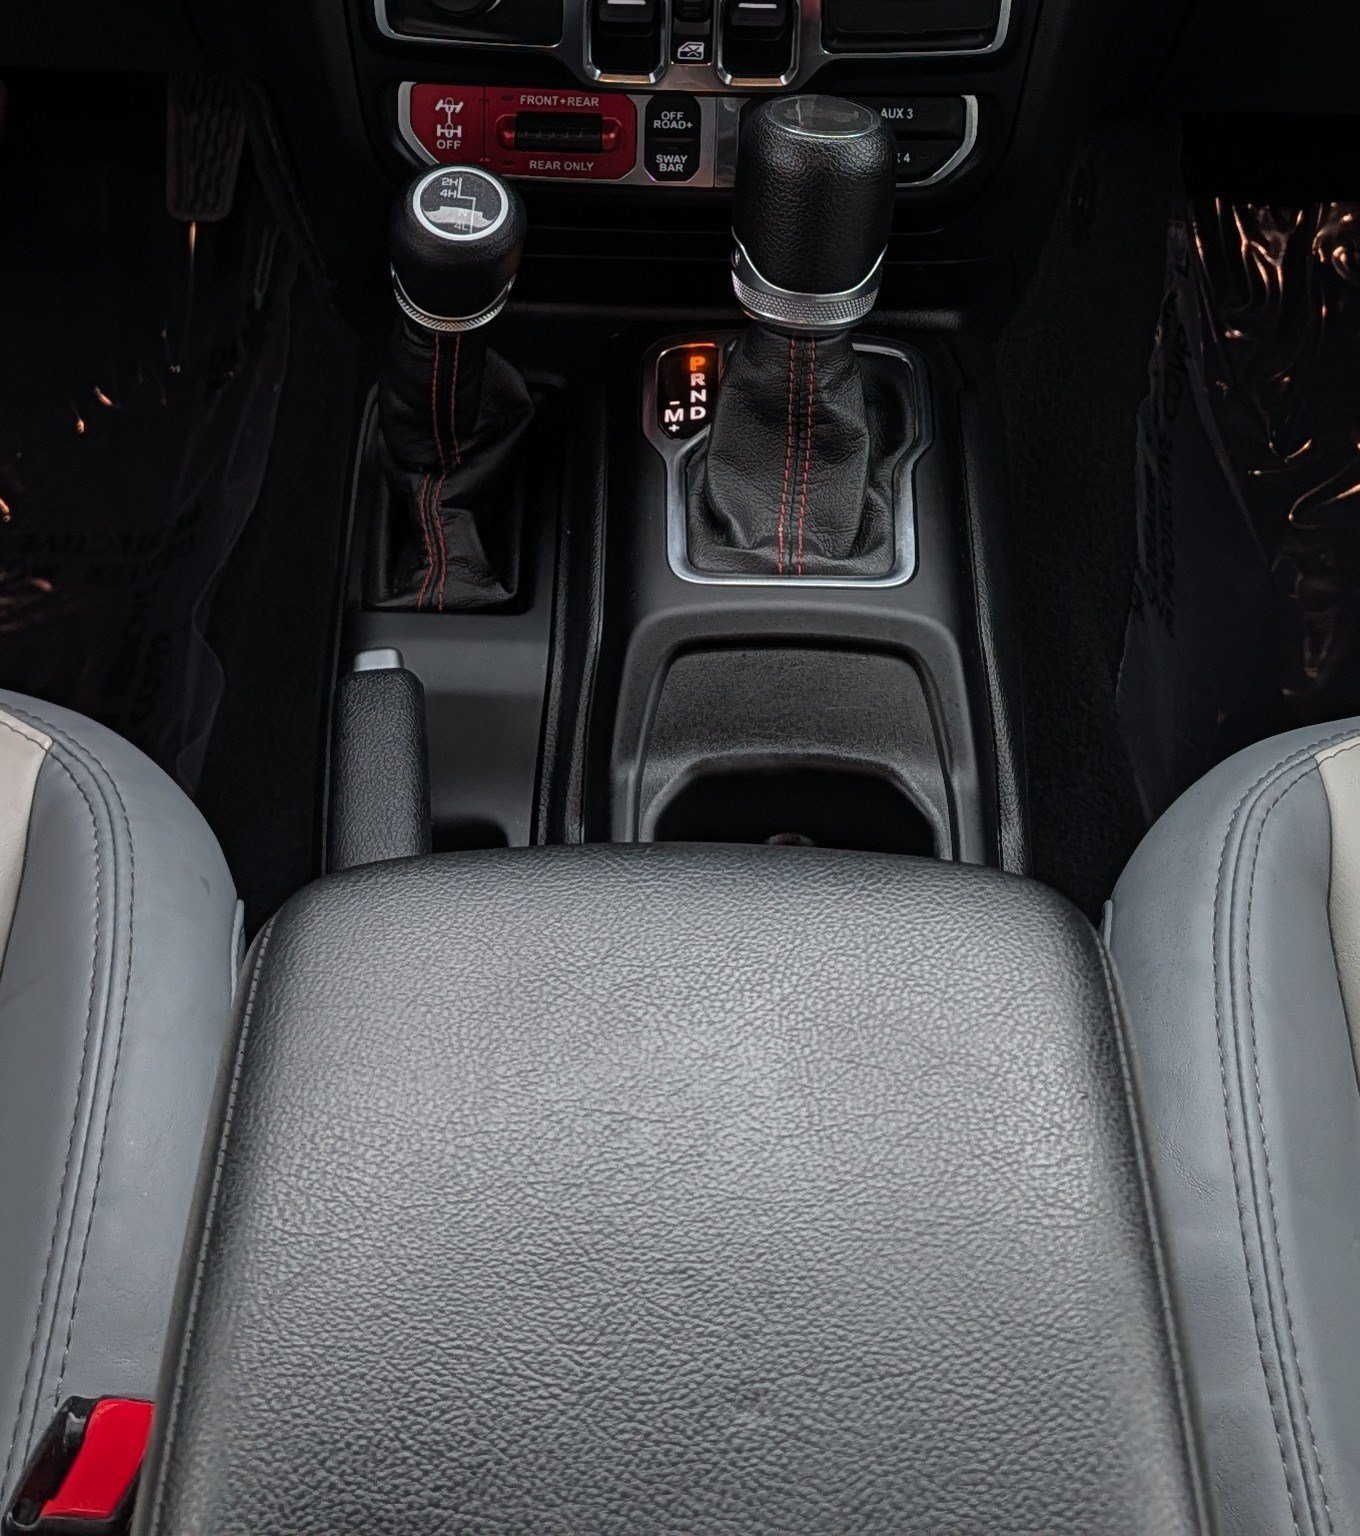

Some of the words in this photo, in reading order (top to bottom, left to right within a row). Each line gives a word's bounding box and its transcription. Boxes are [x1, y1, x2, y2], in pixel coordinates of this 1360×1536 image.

[661, 111, 684, 120] OFF
[880, 108, 904, 119] AUX
[906, 108, 914, 119] 3
[436, 139, 462, 150] OFF
[655, 154, 688, 164] SWAY
[529, 160, 561, 171] REAR
[564, 161, 594, 172] ONLY
[659, 163, 684, 173] BAR
[441, 177, 458, 186] 2H
[440, 189, 457, 198] 4H
[453, 222, 468, 231] 4L
[690, 356, 705, 371] P
[690, 373, 706, 387] R
[690, 389, 707, 403] N
[664, 408, 684, 423] M
[690, 406, 707, 420] D
